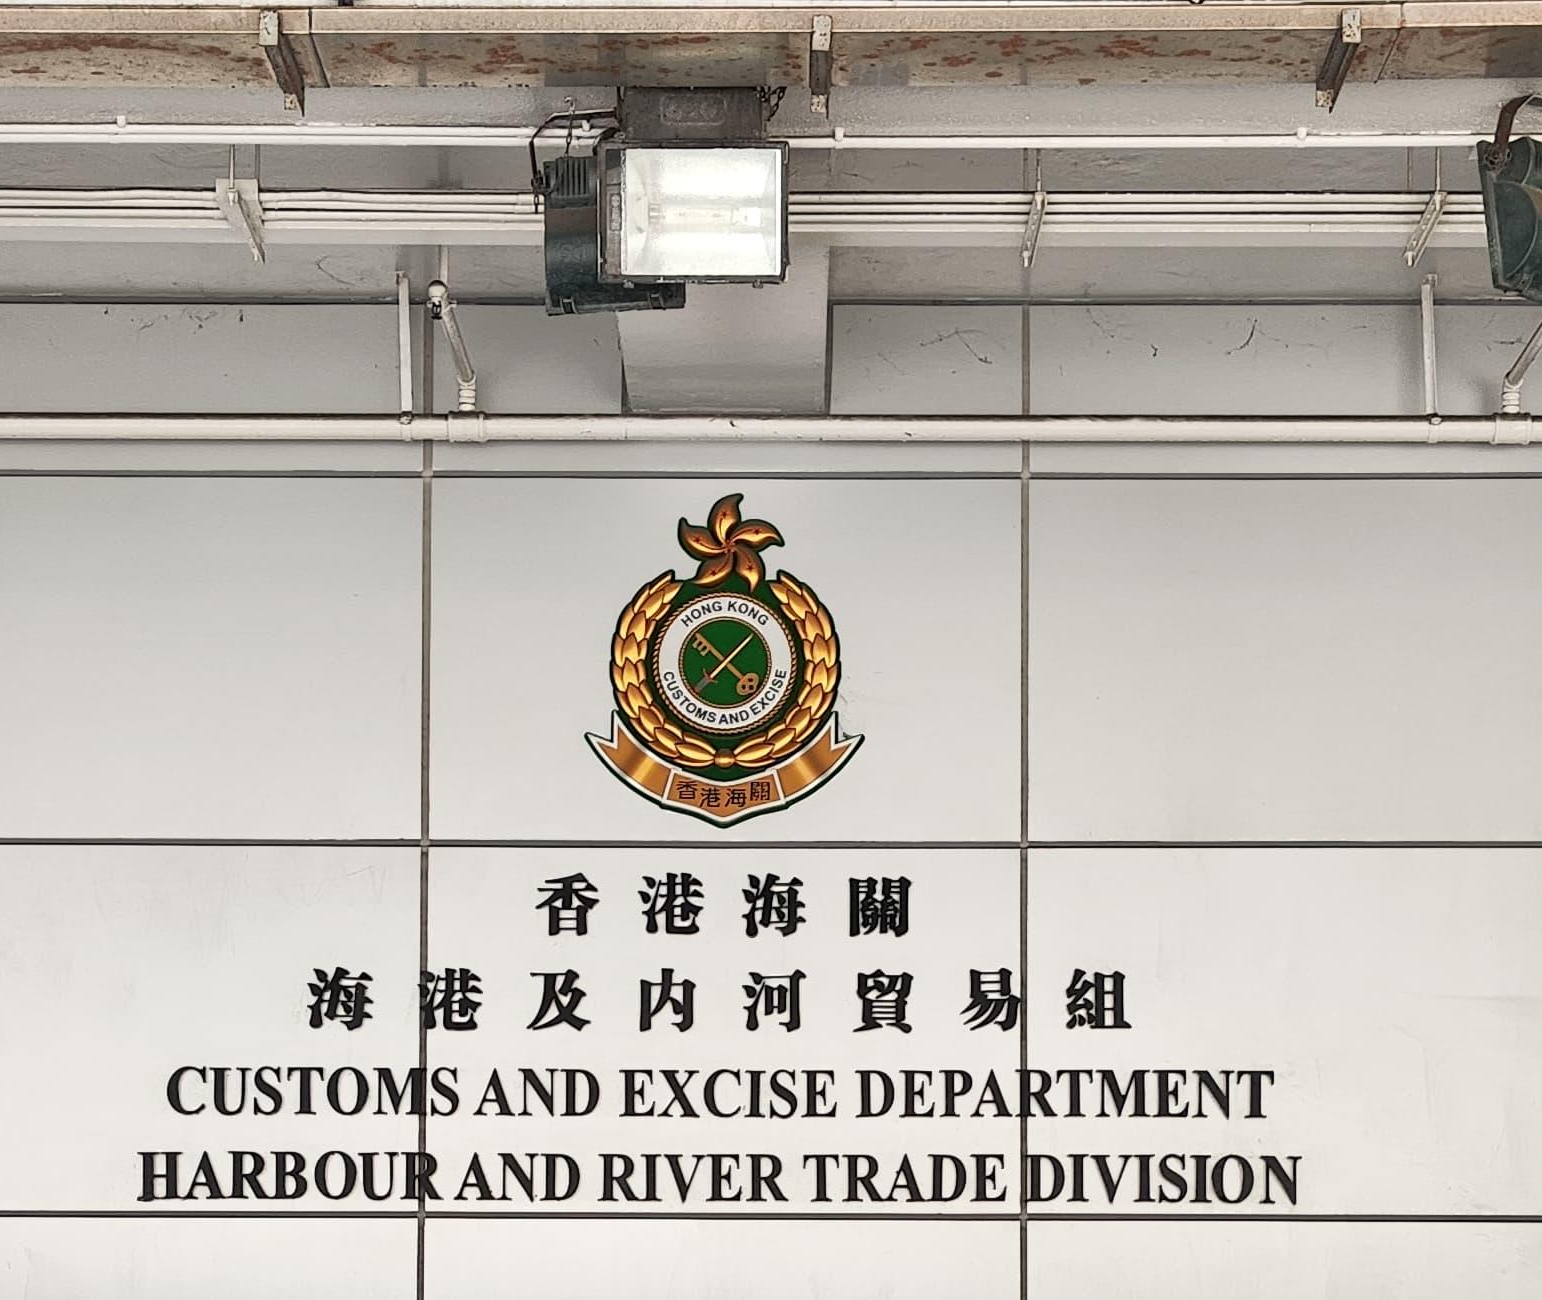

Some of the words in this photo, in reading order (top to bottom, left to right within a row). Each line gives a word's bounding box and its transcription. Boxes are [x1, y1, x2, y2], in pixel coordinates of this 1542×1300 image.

[680, 600, 722, 628] HONG
[727, 600, 769, 626] KONG
[663, 671, 717, 723] CUSTOMS
[718, 710, 750, 725] AND
[750, 668, 788, 716] EXCISE
[676, 780, 771, 808] 香港海關
[536, 873, 912, 938] 香港海關
[166, 1066, 460, 1116] CUSTOMS
[473, 1068, 600, 1117] AND
[619, 1069, 837, 1119] EXCISE
[855, 1069, 1275, 1119] DEPARTMENT
[137, 1150, 444, 1202] HARBOUR
[453, 1152, 581, 1202] AND
[597, 1153, 789, 1203] RIVER
[803, 1153, 1007, 1203] TRADE
[1024, 1153, 1302, 1205] DIVISION
